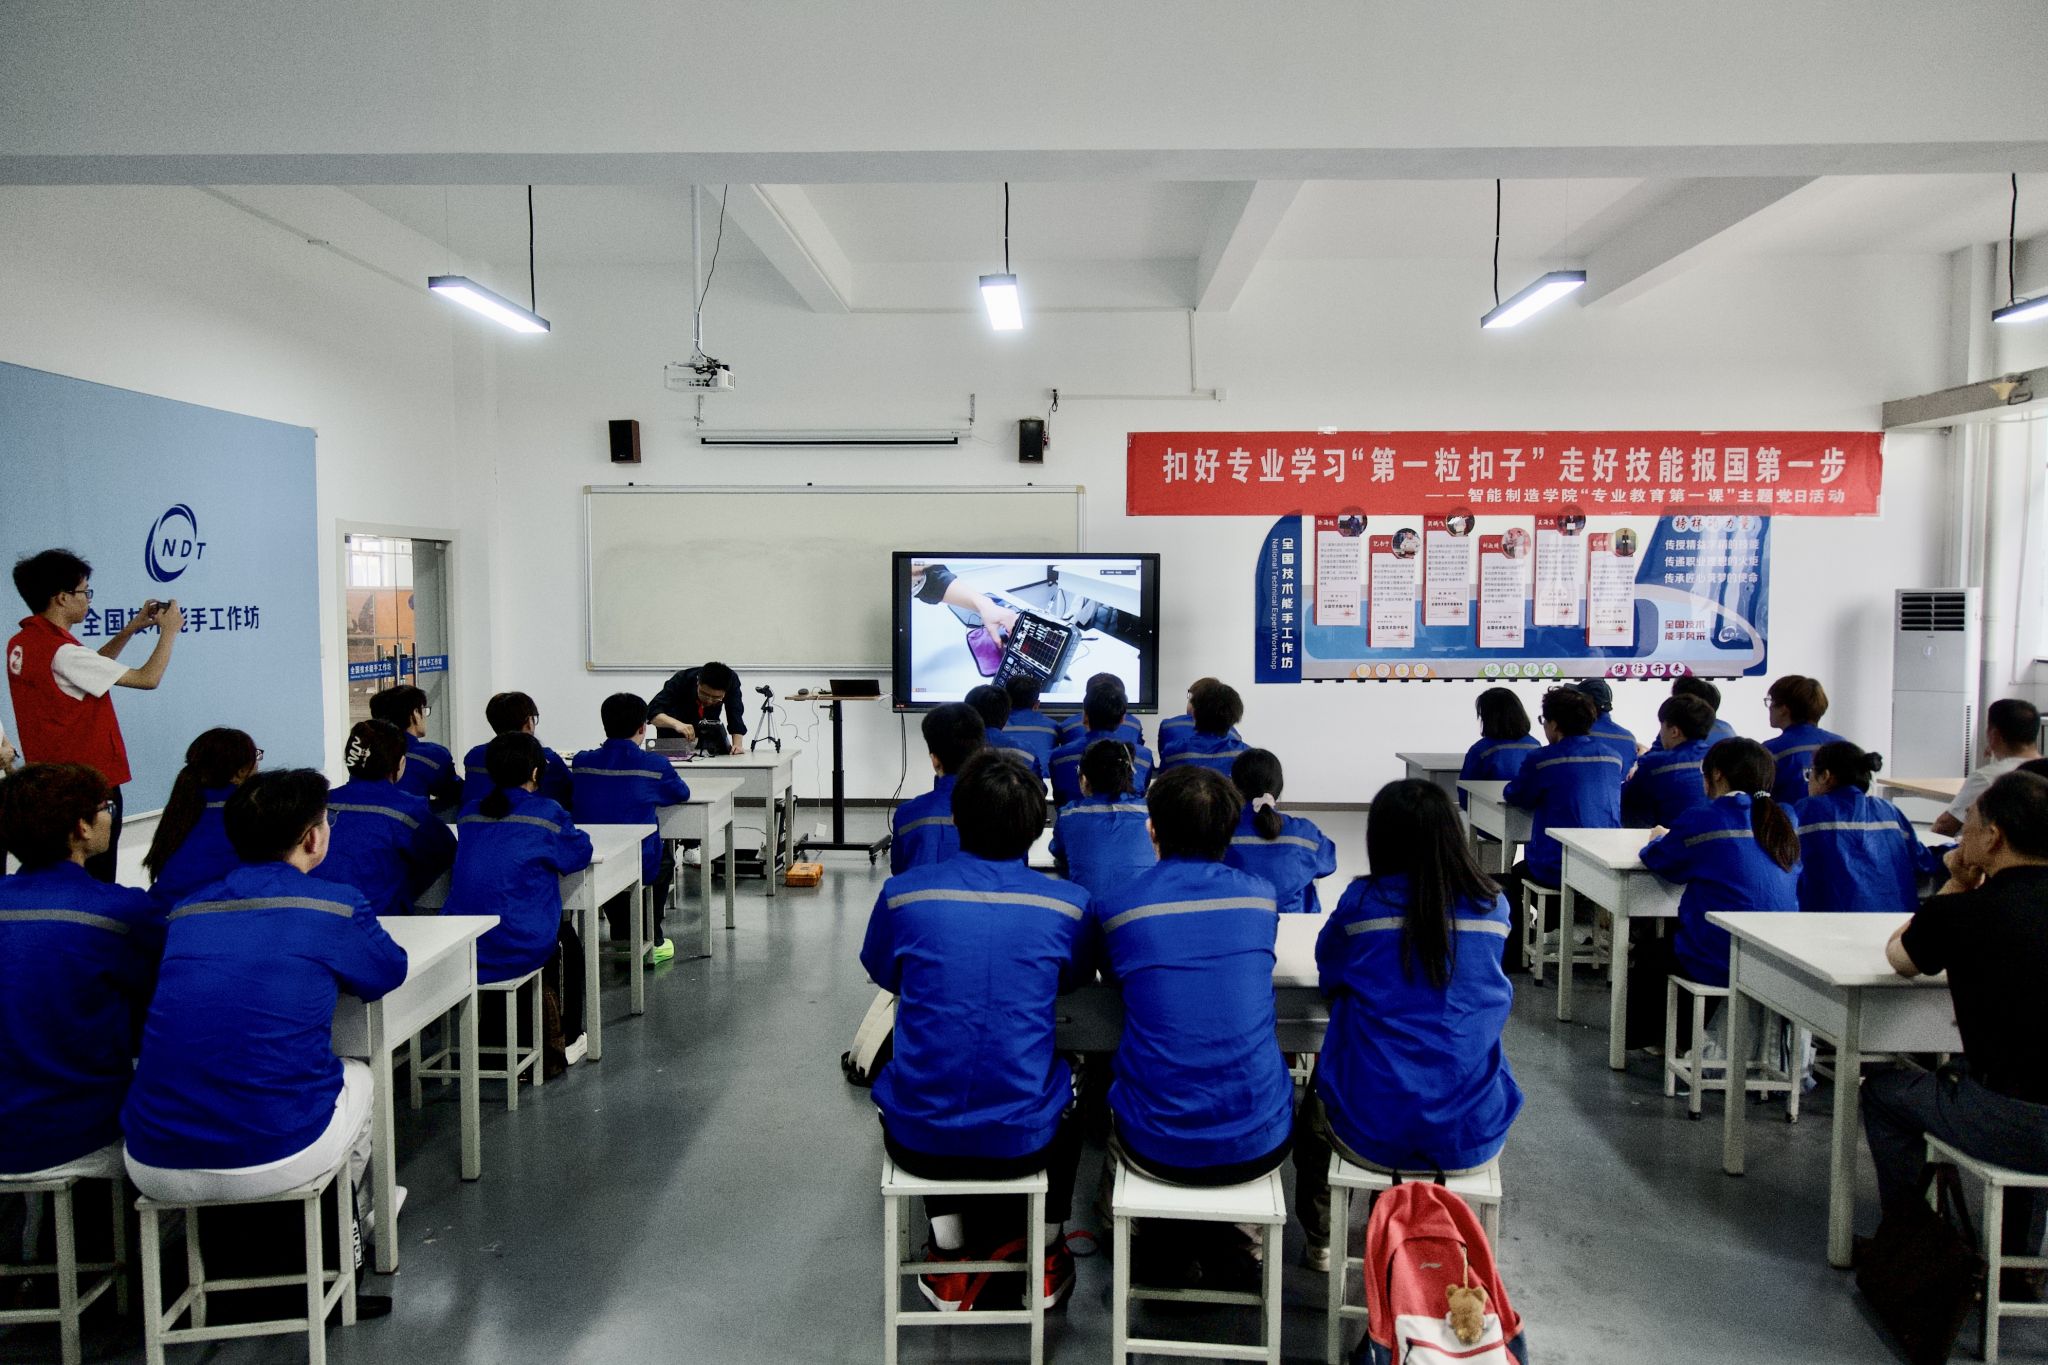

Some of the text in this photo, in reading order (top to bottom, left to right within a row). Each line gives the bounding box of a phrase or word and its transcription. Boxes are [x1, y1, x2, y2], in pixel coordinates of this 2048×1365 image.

[162, 538, 207, 560] NDT
[1270, 538, 1279, 670] National Technical Expert Workshop
[1281, 537, 1294, 669] 全国技术能手工作坊
[82, 605, 260, 637] 全国手工作坊
[1665, 619, 1705, 629] 全国技术
